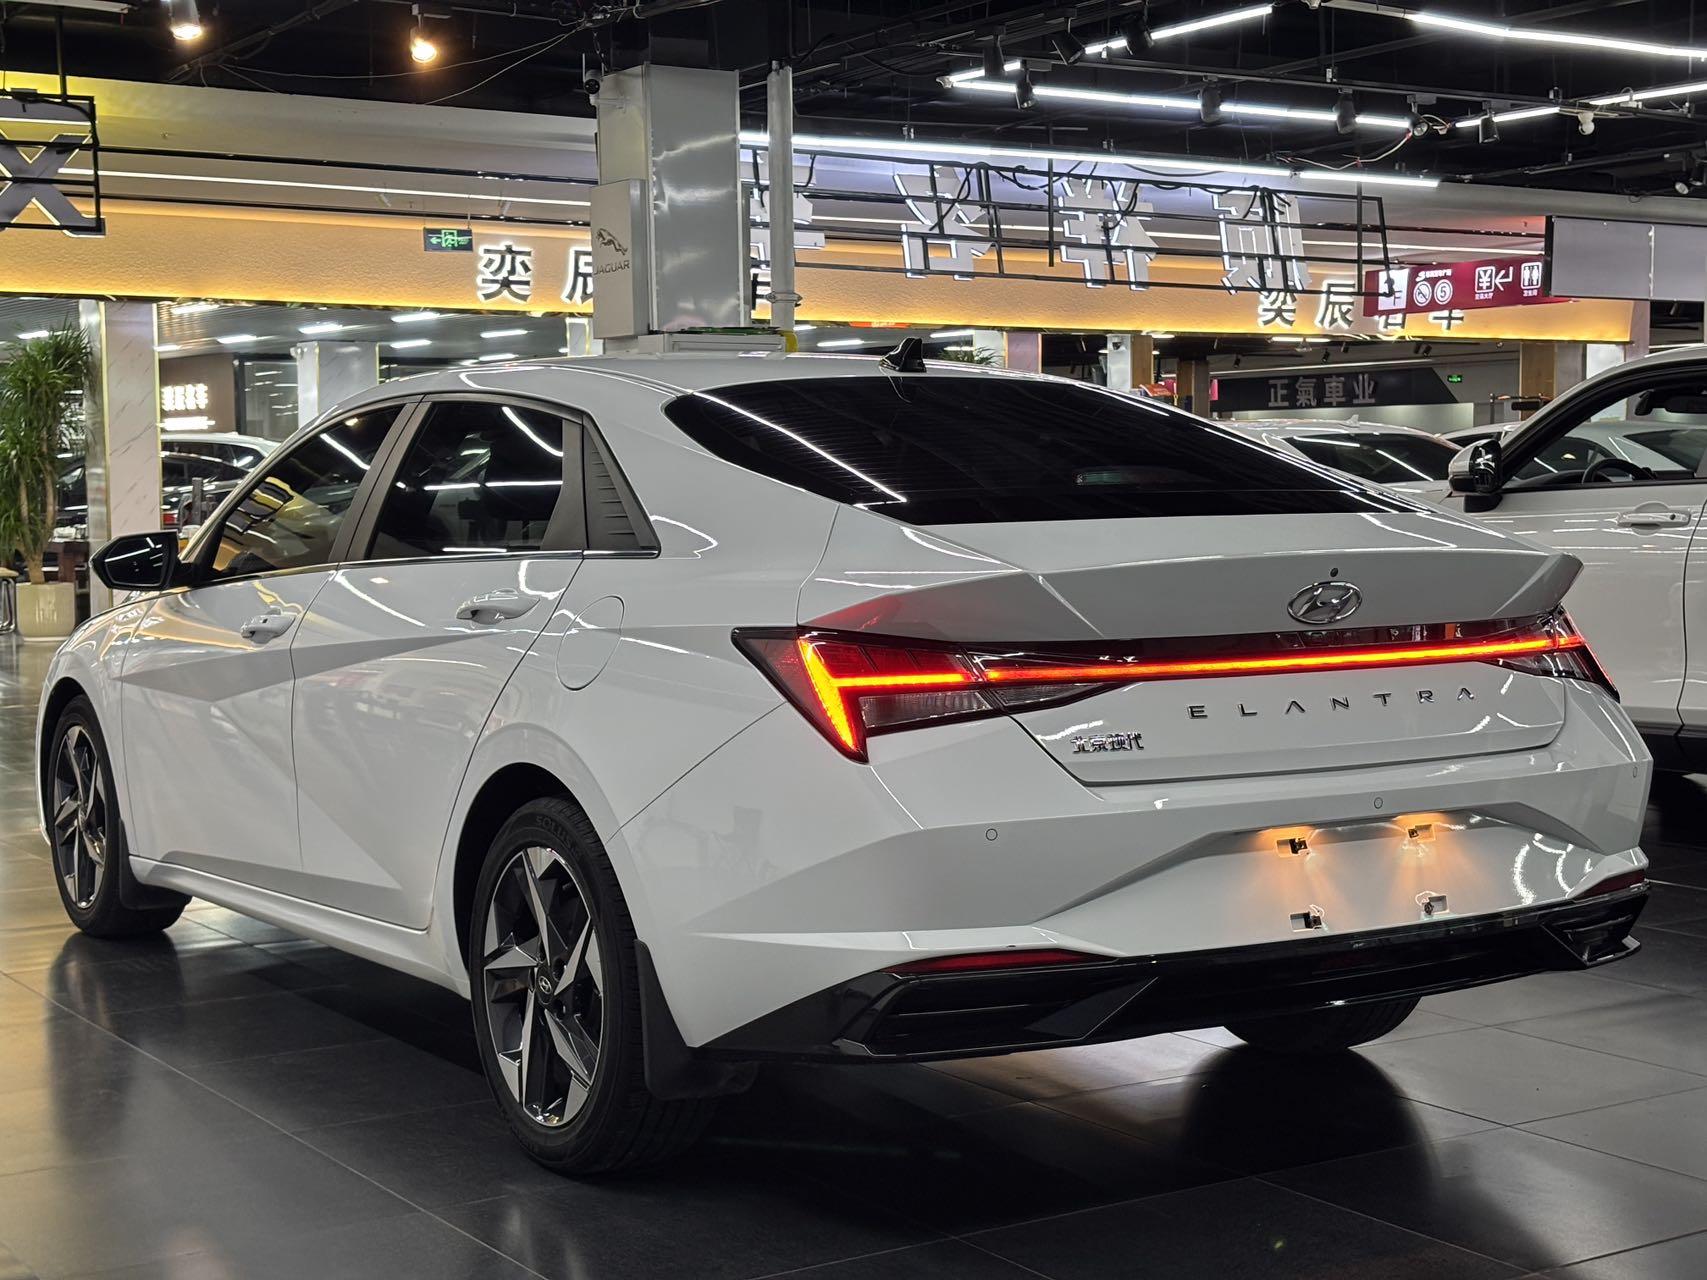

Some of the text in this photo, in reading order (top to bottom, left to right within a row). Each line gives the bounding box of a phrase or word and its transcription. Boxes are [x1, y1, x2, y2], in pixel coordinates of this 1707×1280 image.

[594, 259, 631, 276] JAGUAR
[1268, 373, 1376, 407] 正氣車业
[1187, 687, 1475, 719] ELANTRA
[1071, 733, 1145, 754] 北京现代
